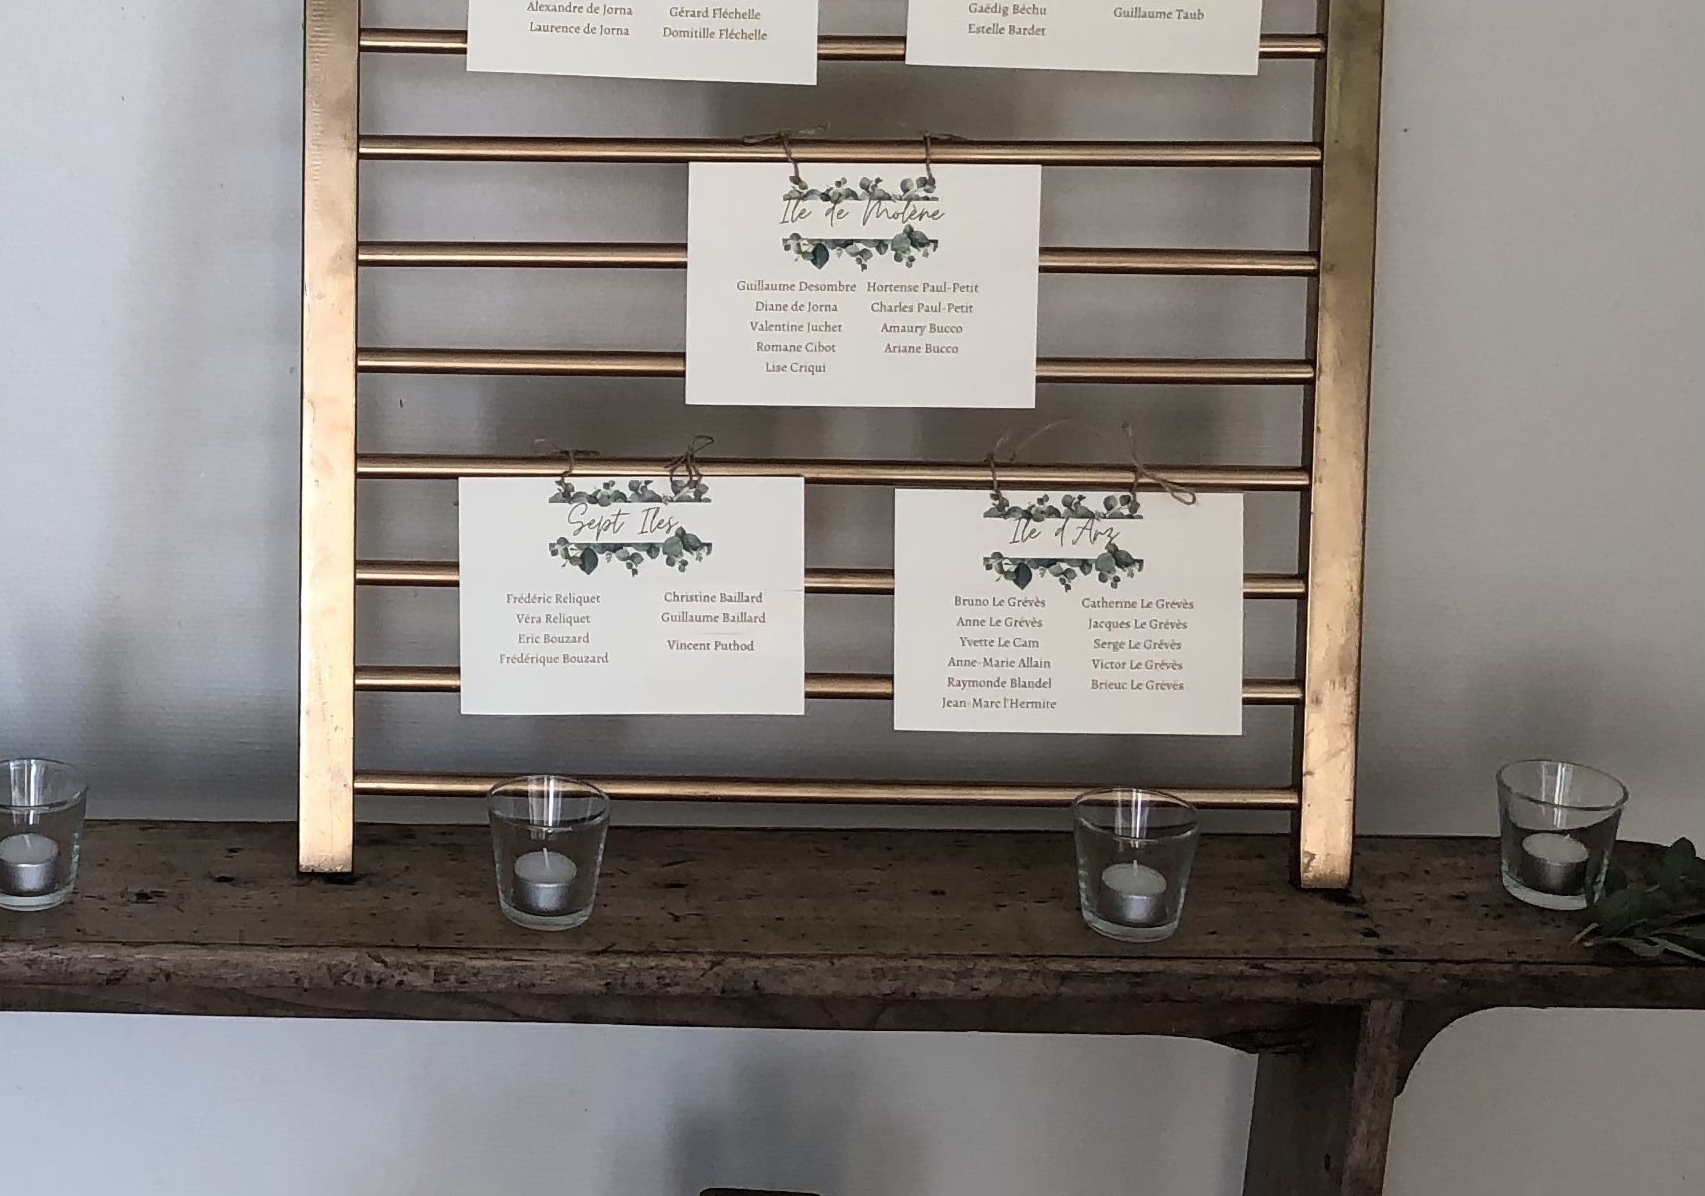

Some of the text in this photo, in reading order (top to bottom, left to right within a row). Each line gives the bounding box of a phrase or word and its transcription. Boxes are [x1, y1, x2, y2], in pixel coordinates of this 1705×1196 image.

[1113, 6, 1204, 20] Guillaume Taub
[824, 200, 850, 227] de
[862, 198, 946, 226] Molène
[737, 279, 857, 292] Guillaume Desombre
[755, 301, 838, 313] Diane de Jorna
[567, 503, 630, 540] Sept
[664, 591, 763, 603] Christine Baillard
[518, 632, 590, 644] Eric Bouzard
[959, 636, 1039, 648] Yvette Le Cam
[667, 639, 755, 651] Vincent Puthod
[947, 676, 1052, 691] Raymonde Blandel
